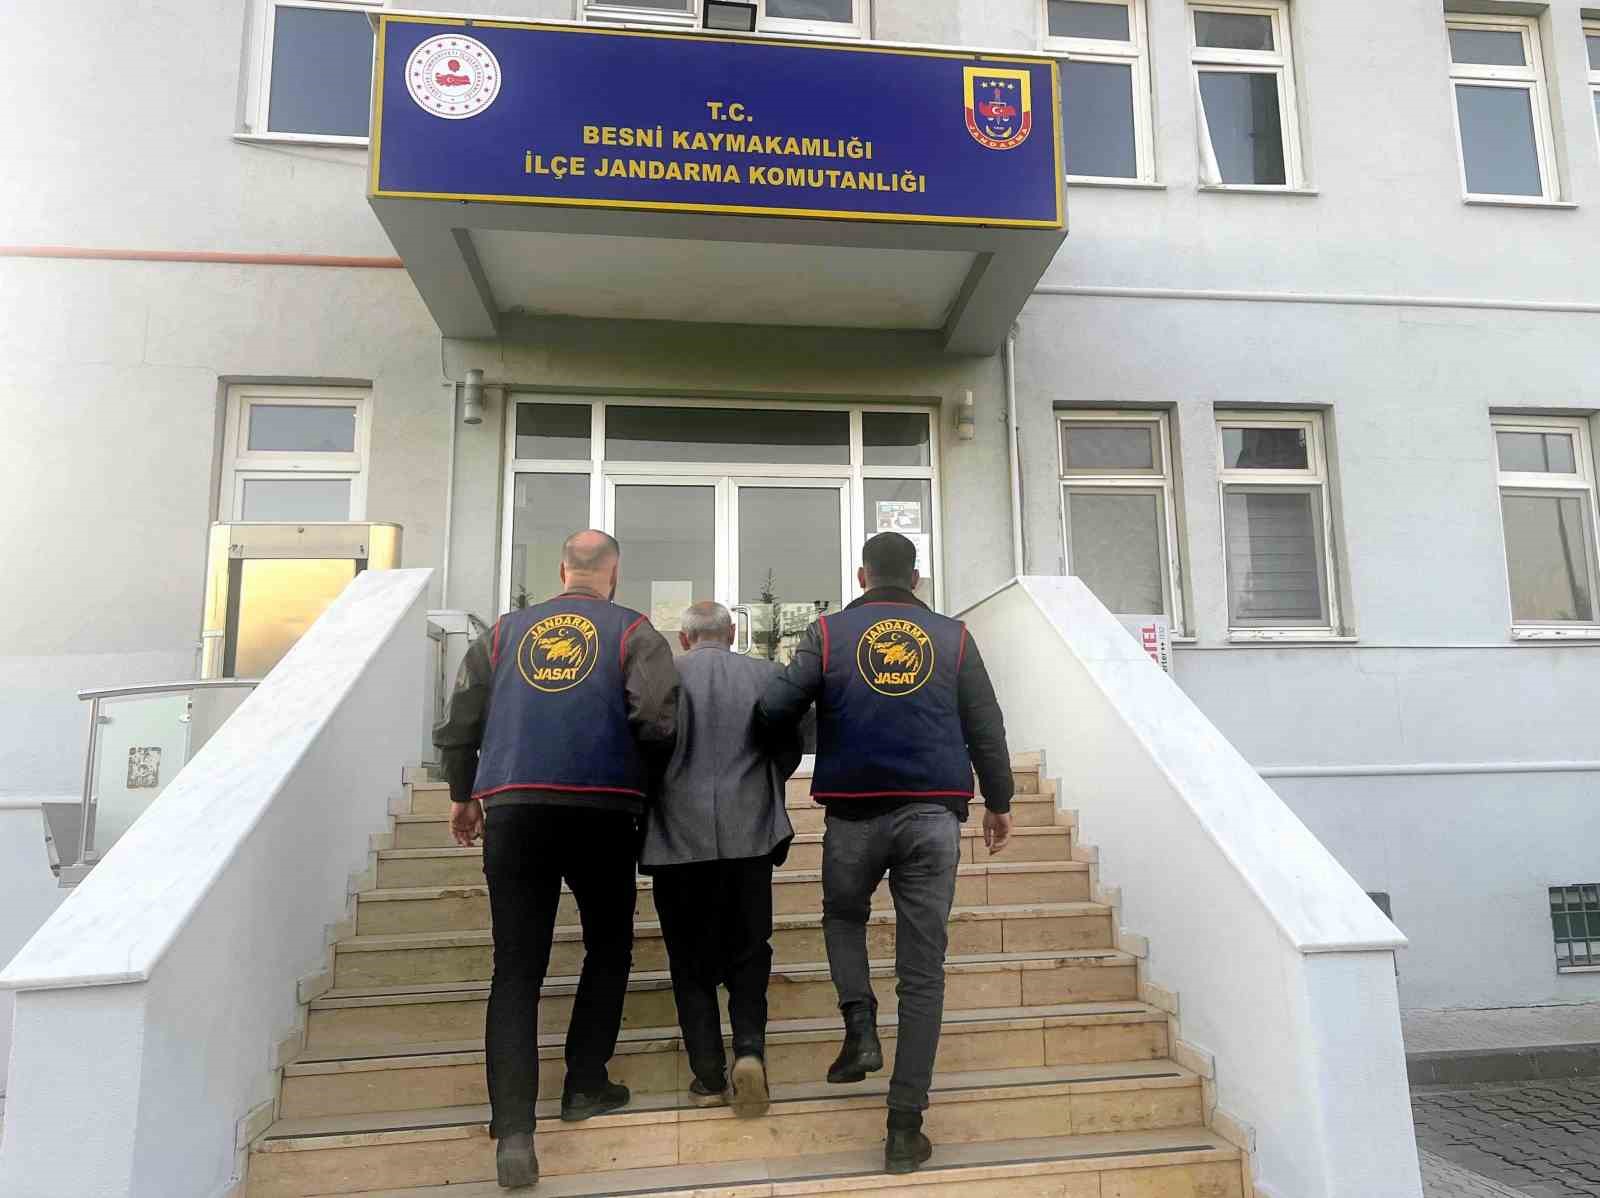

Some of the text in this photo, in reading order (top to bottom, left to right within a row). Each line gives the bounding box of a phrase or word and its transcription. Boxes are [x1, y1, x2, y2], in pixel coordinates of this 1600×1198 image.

[708, 102, 753, 121] T.C.
[583, 126, 872, 160] BESNİ KAYMAKAMLIĞI
[525, 151, 926, 193] İLÇE JANDARMA KOMUTANLIĞI
[531, 616, 595, 640] JANDARMA
[864, 621, 928, 646] JANDARMA
[533, 668, 578, 680] JASAT
[874, 672, 917, 684] JASAT
